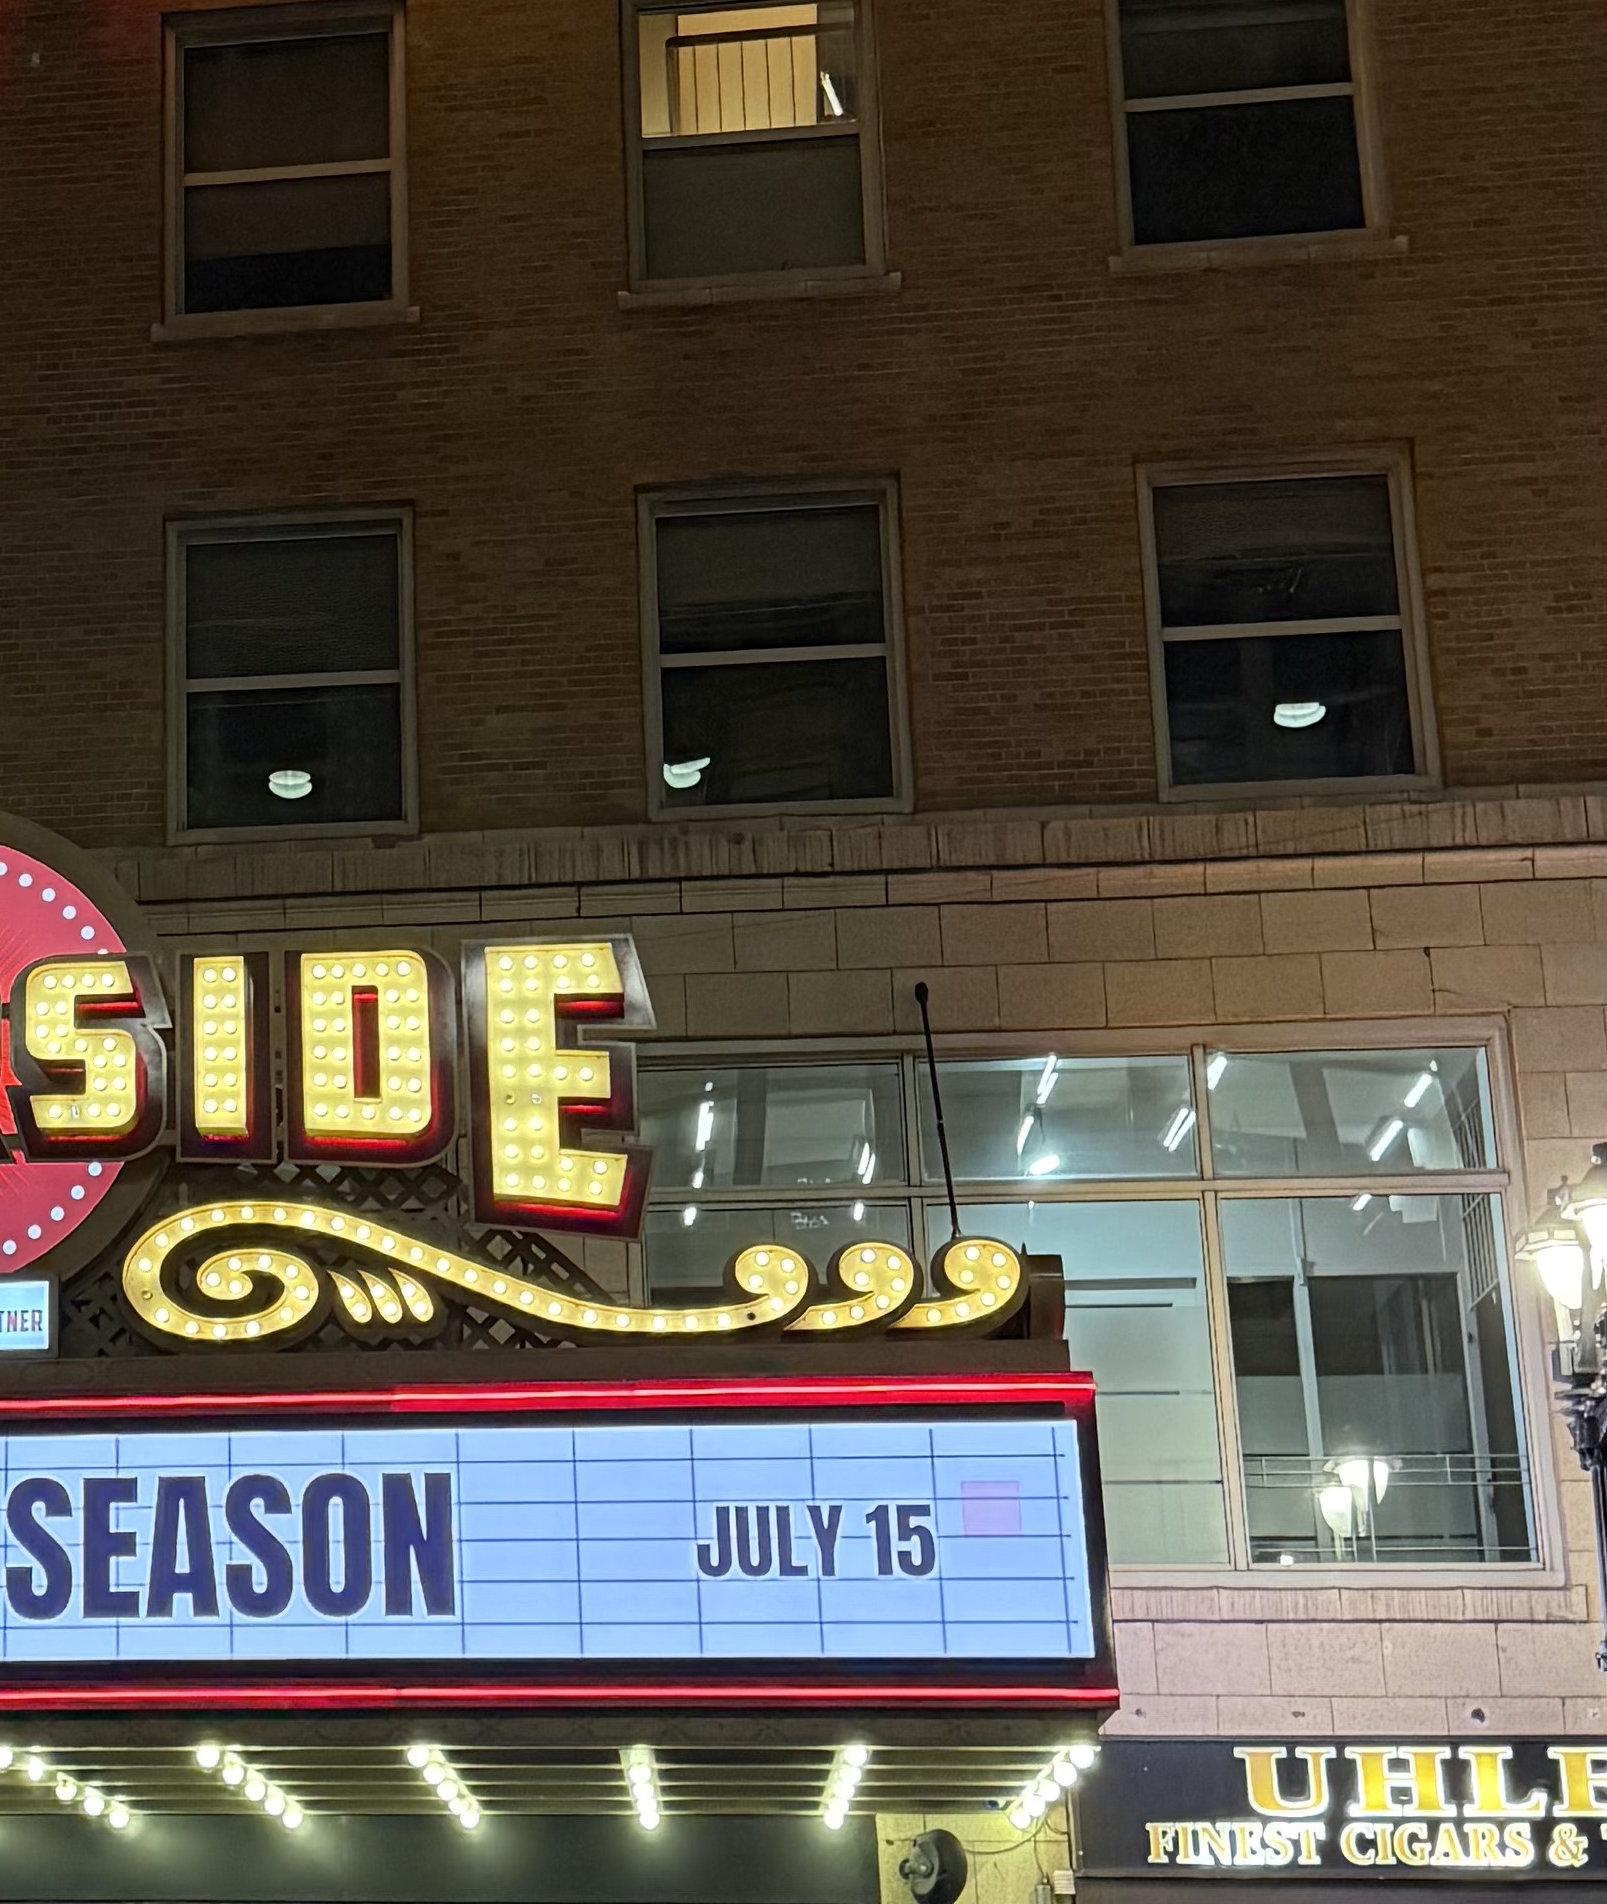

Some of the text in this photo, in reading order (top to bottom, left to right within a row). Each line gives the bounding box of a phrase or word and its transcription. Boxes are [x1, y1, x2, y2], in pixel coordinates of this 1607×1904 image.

[5, 1471, 457, 1620] SEASON
[695, 1504, 842, 1580] JULY
[865, 1502, 936, 1578] 15
[1145, 1821, 1589, 1868] FINEST CIGARS &
